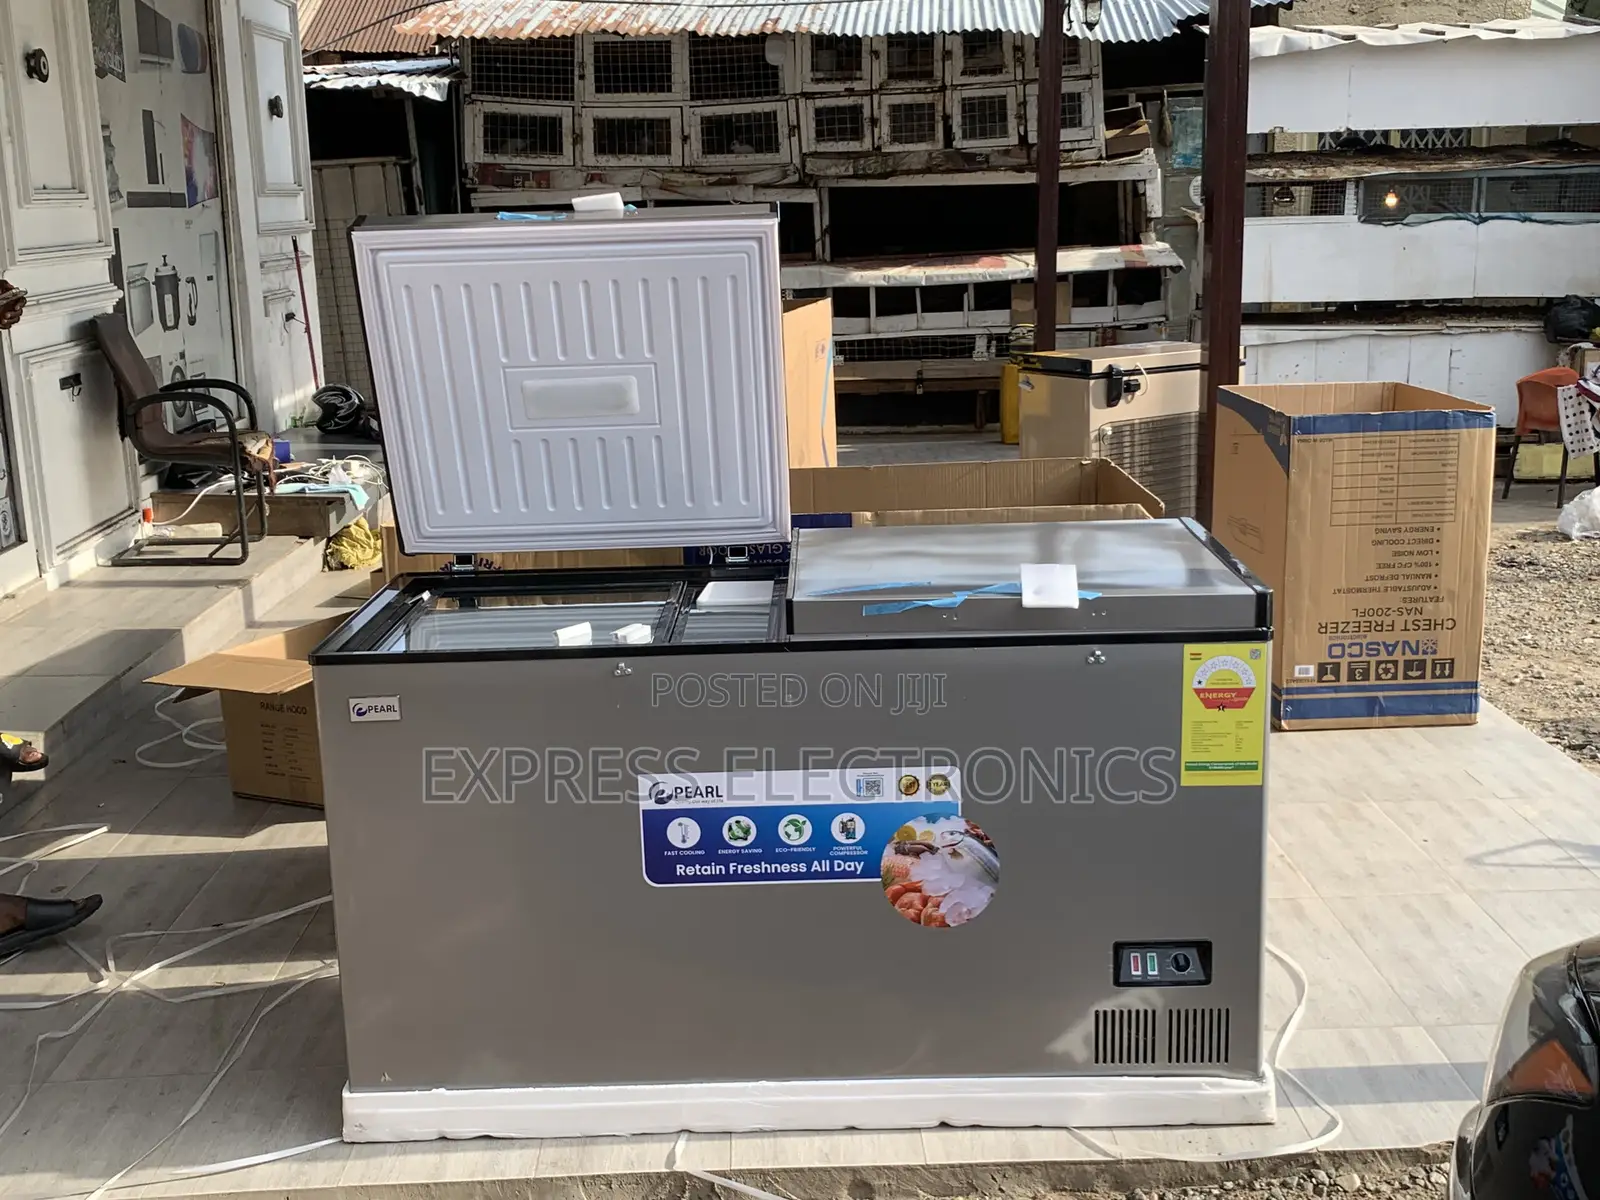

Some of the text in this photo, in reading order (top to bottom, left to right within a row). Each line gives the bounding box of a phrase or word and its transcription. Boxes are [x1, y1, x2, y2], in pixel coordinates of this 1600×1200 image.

[1371, 537, 1434, 546] DIRECT COOLING
[1364, 574, 1400, 582] DEFROST
[1332, 584, 1432, 595] ADJUSTABLE THERMOSTAT
[1399, 595, 1445, 604] FEATURES:
[1351, 606, 1424, 618] NAS-200FL
[1317, 617, 1457, 635] CHEST FREEZER
[1327, 639, 1420, 660] NASCO
[1199, 692, 1237, 700] ENERGY
[259, 701, 308, 715] RANGE HOOD
[367, 704, 398, 714] PEARL
[674, 785, 724, 800] PEARL
[676, 859, 865, 876] Retain Freshness All Day
